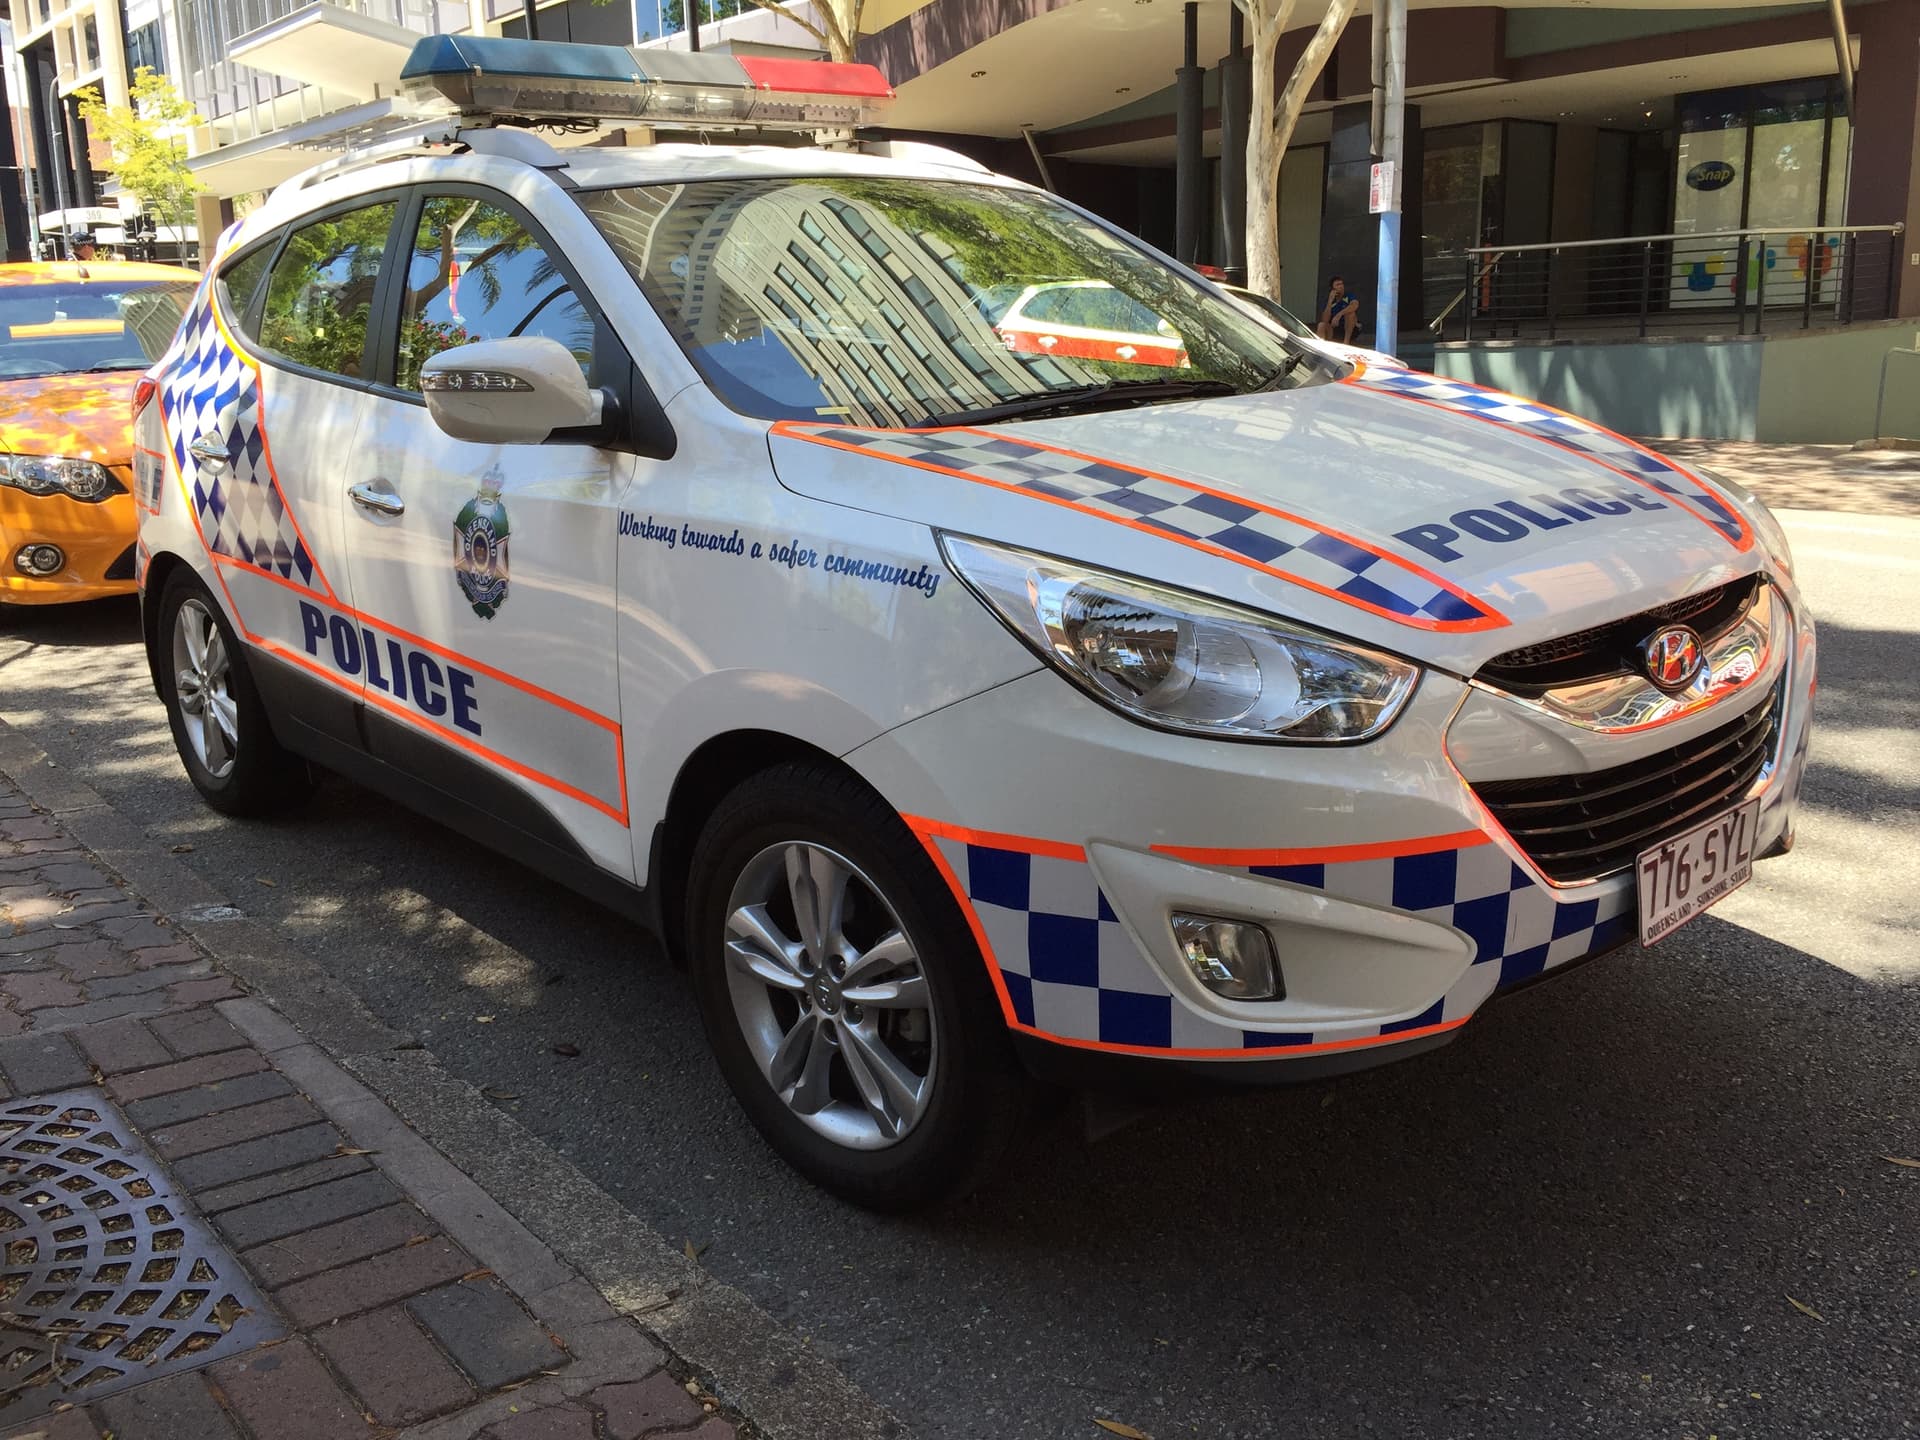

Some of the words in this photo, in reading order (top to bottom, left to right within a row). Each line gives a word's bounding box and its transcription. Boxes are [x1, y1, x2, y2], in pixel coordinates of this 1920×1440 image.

[1697, 167, 1730, 183] Snap
[465, 517, 497, 558] QUEENSLAND
[618, 510, 677, 549] Working
[681, 523, 745, 556] towards
[750, 542, 763, 560] a
[768, 539, 819, 569] safer
[823, 550, 941, 599] community
[1391, 485, 1669, 563] POLICE
[299, 599, 482, 737] POLICE
[1647, 902, 1692, 939] QUEENSLAND
[1696, 879, 1729, 908] SUNSHINE
[1730, 867, 1748, 887] STATE
